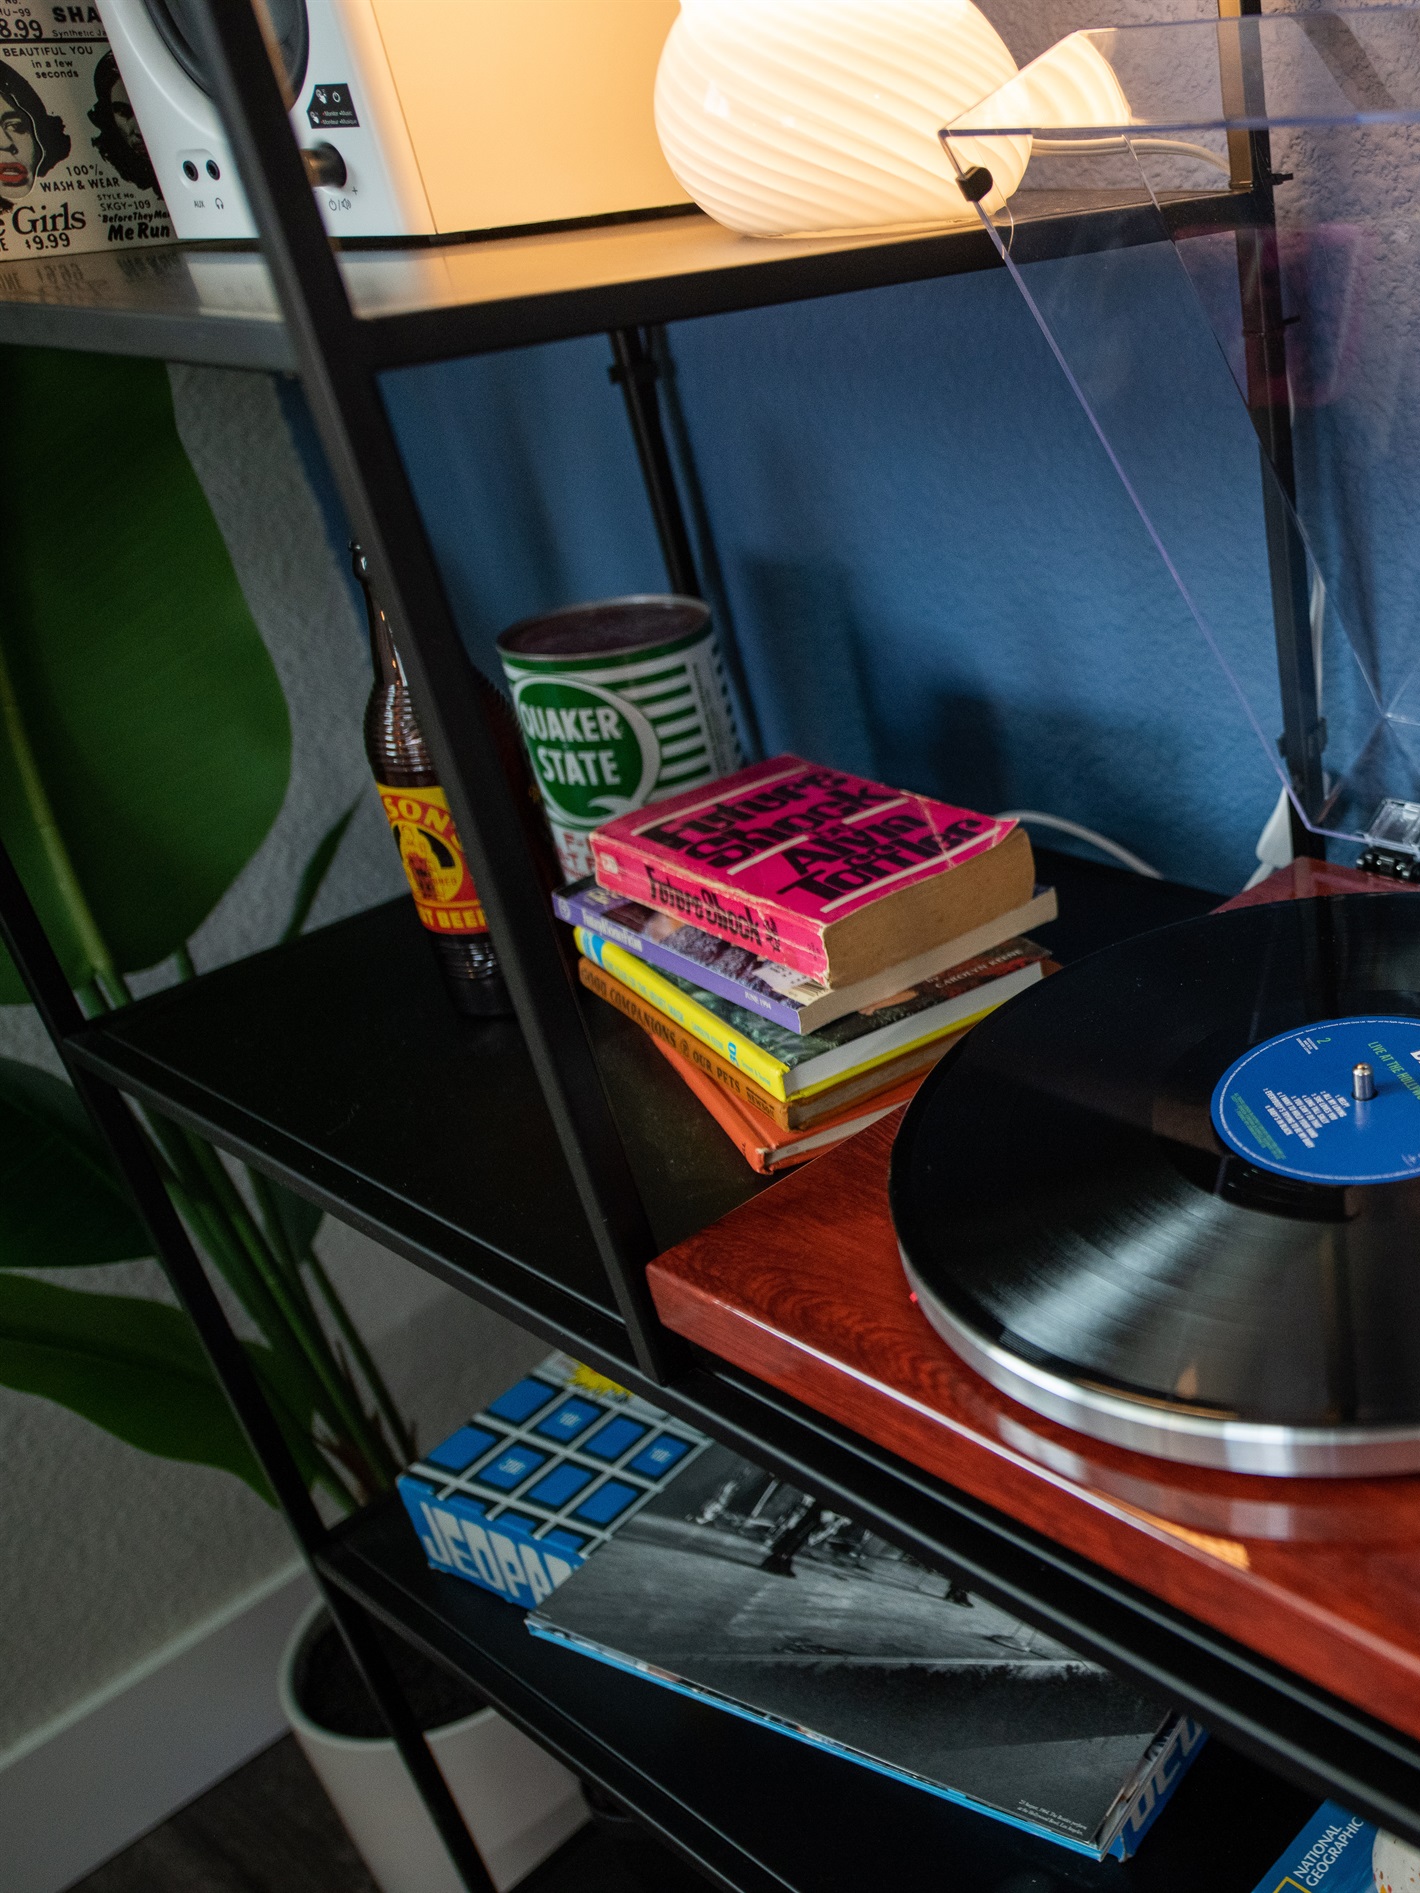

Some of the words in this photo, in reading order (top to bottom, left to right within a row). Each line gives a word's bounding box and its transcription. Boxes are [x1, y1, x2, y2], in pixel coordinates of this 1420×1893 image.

[52, 29, 95, 39] Synthetic
[3, 47, 66, 57] BEAUTIFUL
[69, 46, 93, 55] YOU
[31, 59, 42, 68] in
[55, 59, 73, 68] few
[36, 69, 79, 79] seconds
[40, 181, 74, 192] WASH
[77, 180, 85, 191] &
[87, 177, 120, 190] WEAR
[66, 164, 103, 176] 100%
[97, 193, 121, 201] STYLE
[100, 200, 151, 212] SKGY-109
[12, 202, 86, 235] Girls
[108, 224, 134, 242] Me
[138, 222, 170, 239] Run
[25, 232, 71, 250] $9.99
[520, 701, 623, 743] QUAKER
[537, 745, 621, 786] STATE
[639, 773, 848, 850] Future
[684, 787, 895, 868] Shock
[776, 818, 982, 899] Toffler
[779, 813, 929, 874] Alvin
[645, 865, 703, 919] Future
[701, 889, 762, 946] Shock
[935, 964, 988, 989] CAROLYN
[988, 949, 1023, 966] KEENE
[610, 986, 677, 1049] COMPANIONS
[692, 1050, 713, 1074] OUR
[717, 1069, 741, 1094] PETS
[1367, 1041, 1388, 1056] LIVE
[1379, 1054, 1394, 1062] AT
[1387, 1060, 1405, 1074] THE
[1293, 1825, 1343, 1879] NATIONAL
[1305, 1816, 1364, 1887] GEOGRAPHIC
